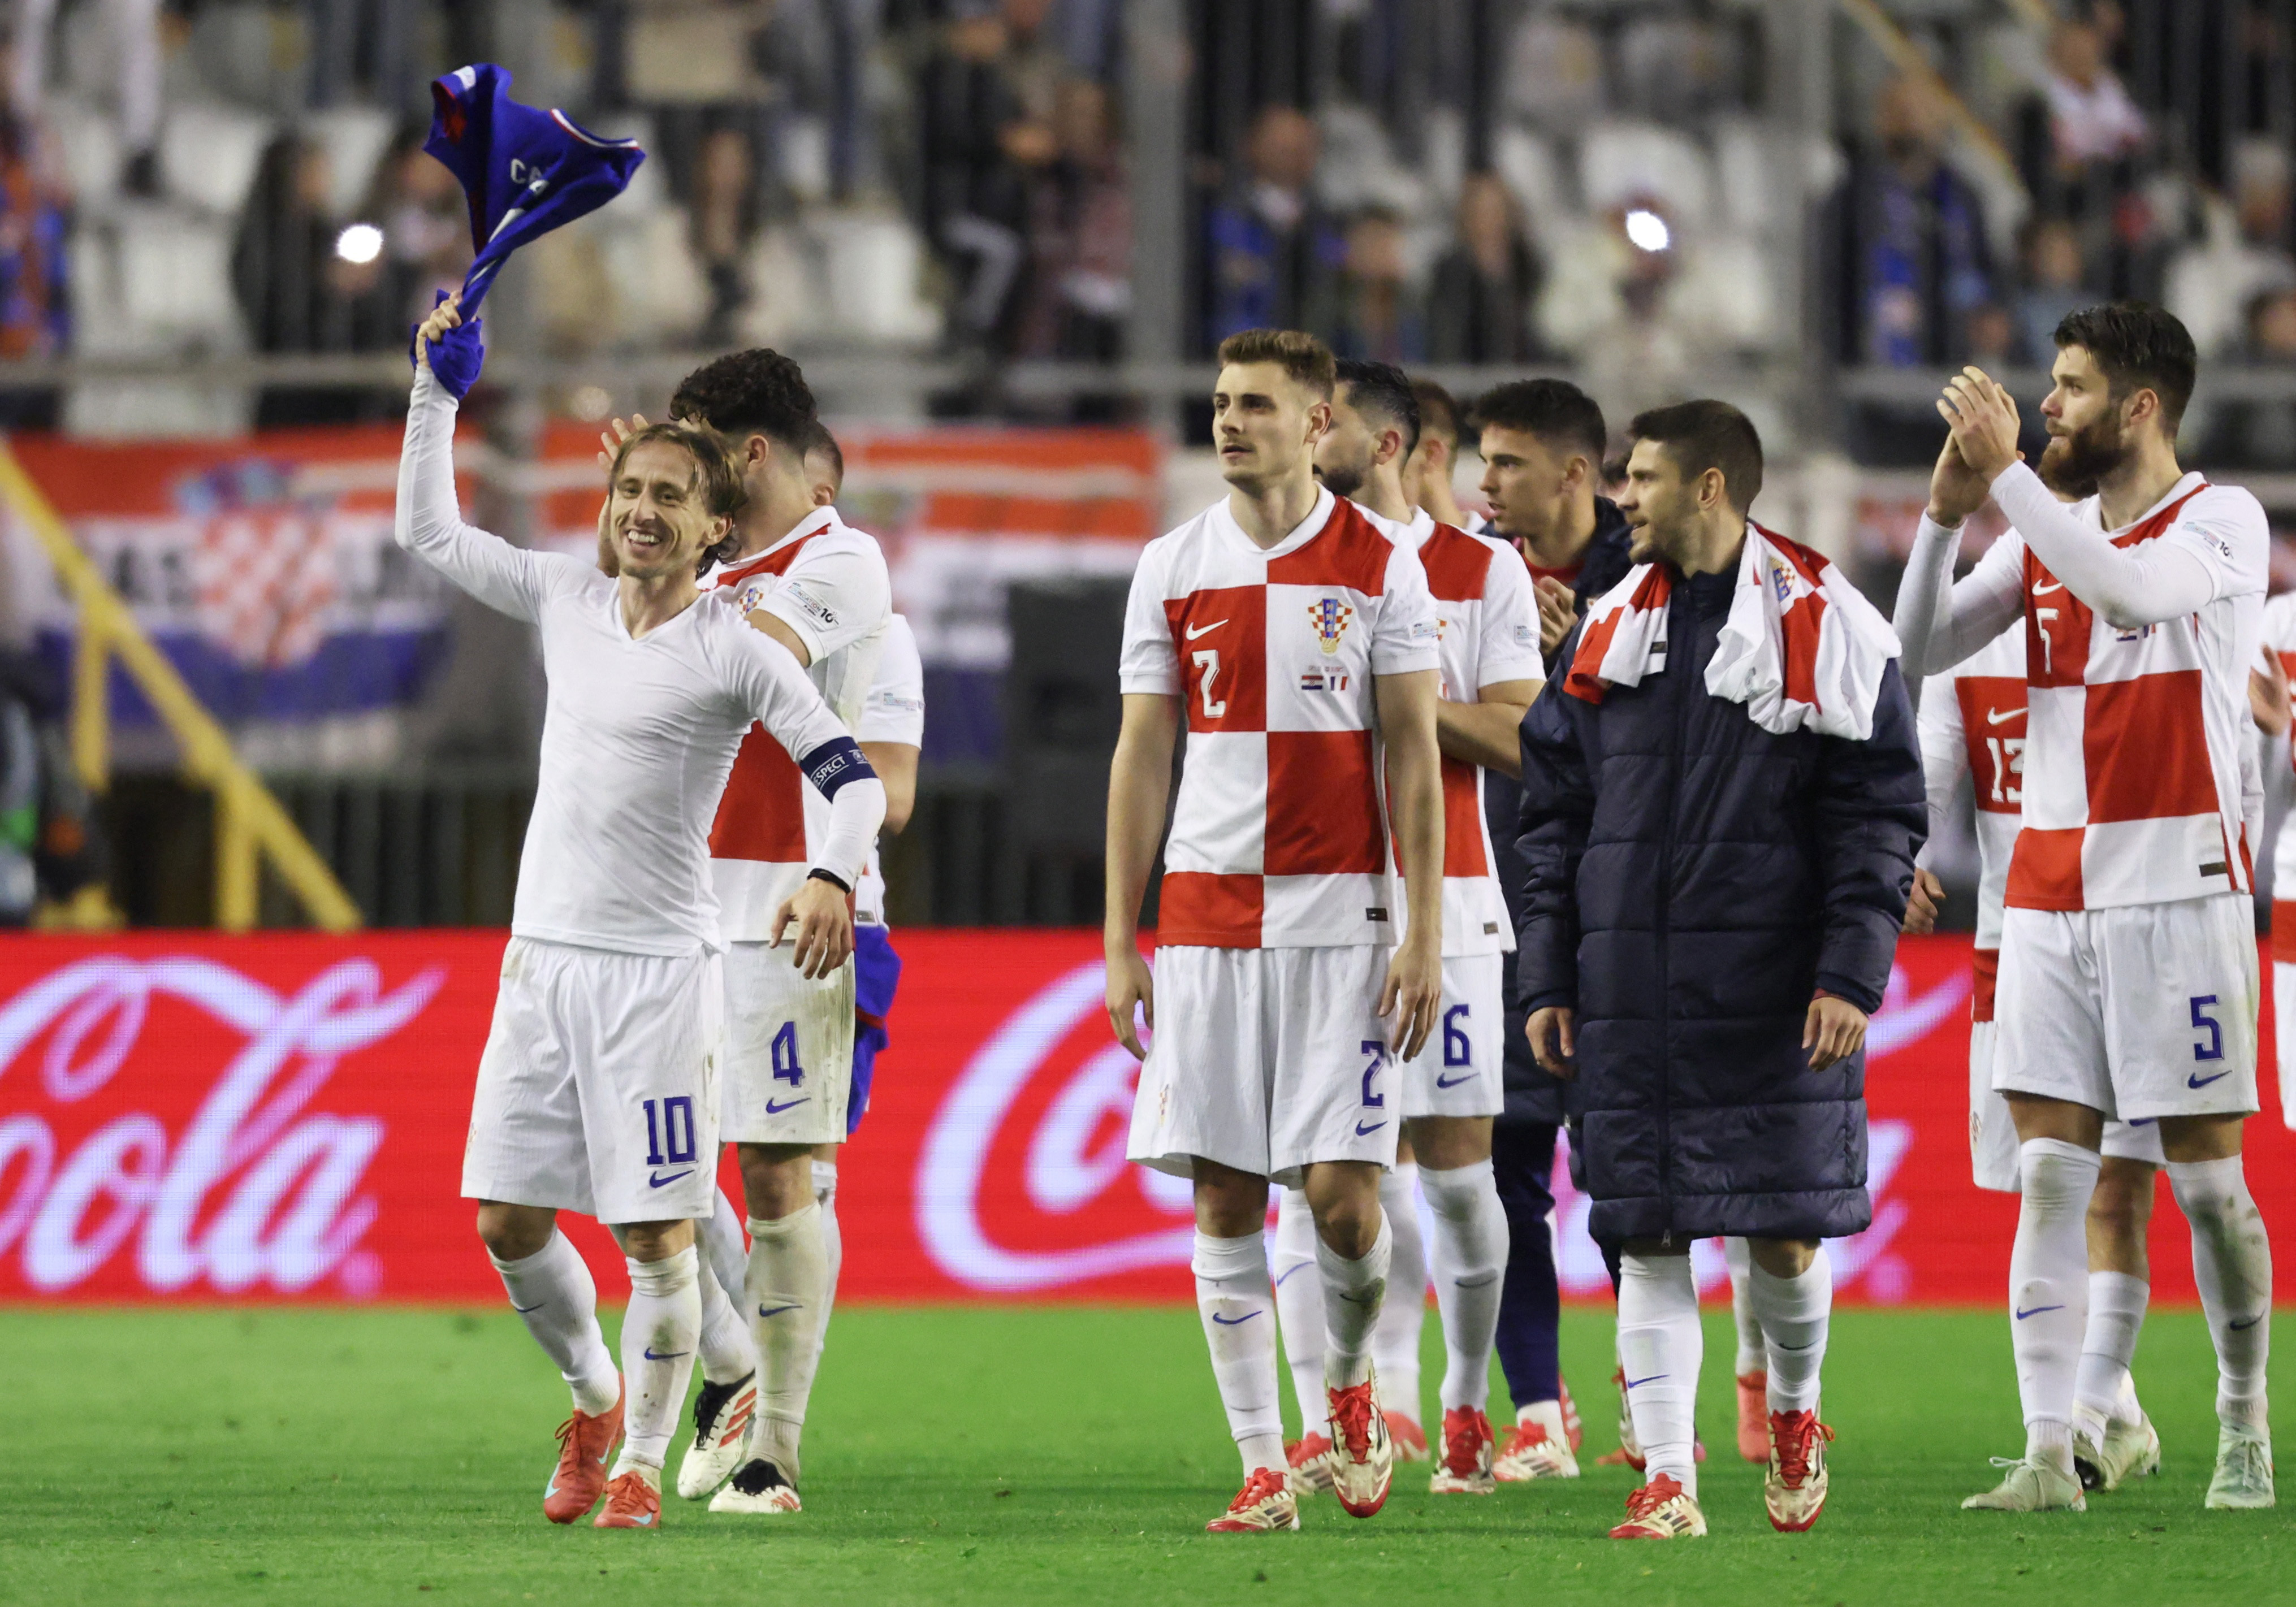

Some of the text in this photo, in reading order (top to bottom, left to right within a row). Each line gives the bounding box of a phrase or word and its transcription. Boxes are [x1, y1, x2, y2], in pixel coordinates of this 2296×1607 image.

[820, 608, 834, 623] 10
[1192, 649, 1226, 718] 2
[771, 1021, 805, 1088] 4
[1443, 1004, 1472, 1068] 6
[2190, 995, 2224, 1063] 5
[1361, 1040, 1385, 1109] 2
[643, 1095, 698, 1167] 10
